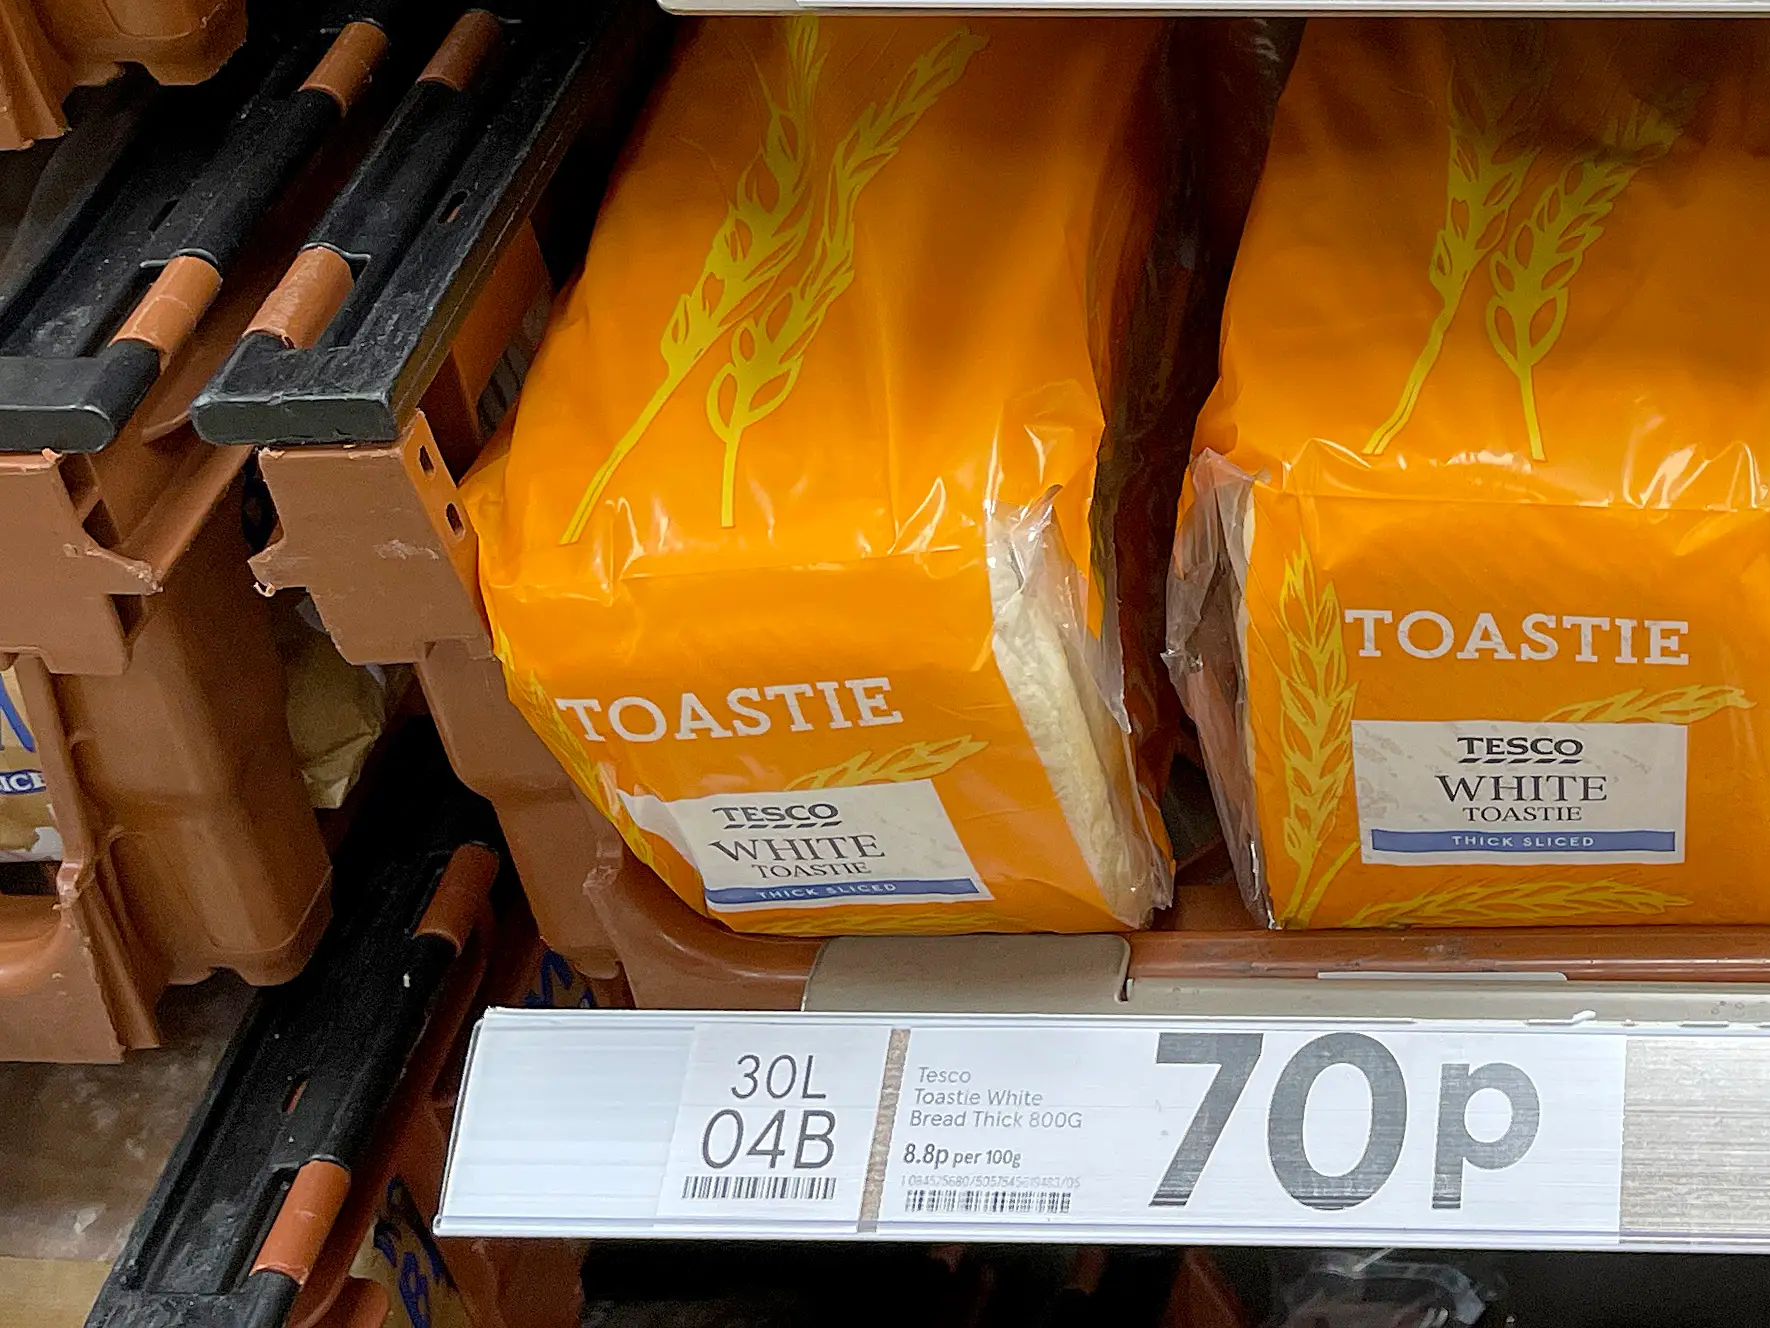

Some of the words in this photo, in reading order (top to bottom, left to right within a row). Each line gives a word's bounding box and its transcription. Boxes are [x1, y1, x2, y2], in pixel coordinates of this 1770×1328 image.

[1344, 608, 1690, 666] TOASTIE
[554, 677, 905, 744] TOASTIE
[1456, 736, 1584, 756] TESCO
[1435, 774, 1608, 803] WHITE
[711, 802, 840, 824] TESCO
[1461, 805, 1583, 823] TOASTIE
[708, 834, 886, 863] WHITE
[1451, 834, 1514, 848] THICK
[1522, 835, 1595, 848] SLICED
[751, 861, 873, 880] TOASTIE
[755, 886, 823, 901] THICK
[825, 882, 897, 896] SLICED
[730, 1054, 827, 1100] 30L
[917, 1066, 972, 1084] Tesco
[913, 1087, 982, 1105] Toastie
[987, 1088, 1044, 1106] White
[909, 1109, 967, 1127] Bread
[973, 1110, 1024, 1128] Thick
[1028, 1111, 1083, 1129] 800G
[1147, 1031, 1541, 1212] 70p
[701, 1109, 836, 1170] 04B
[903, 1142, 949, 1170] 8.8p
[952, 1151, 981, 1168] per
[985, 1149, 1022, 1169] 100g
